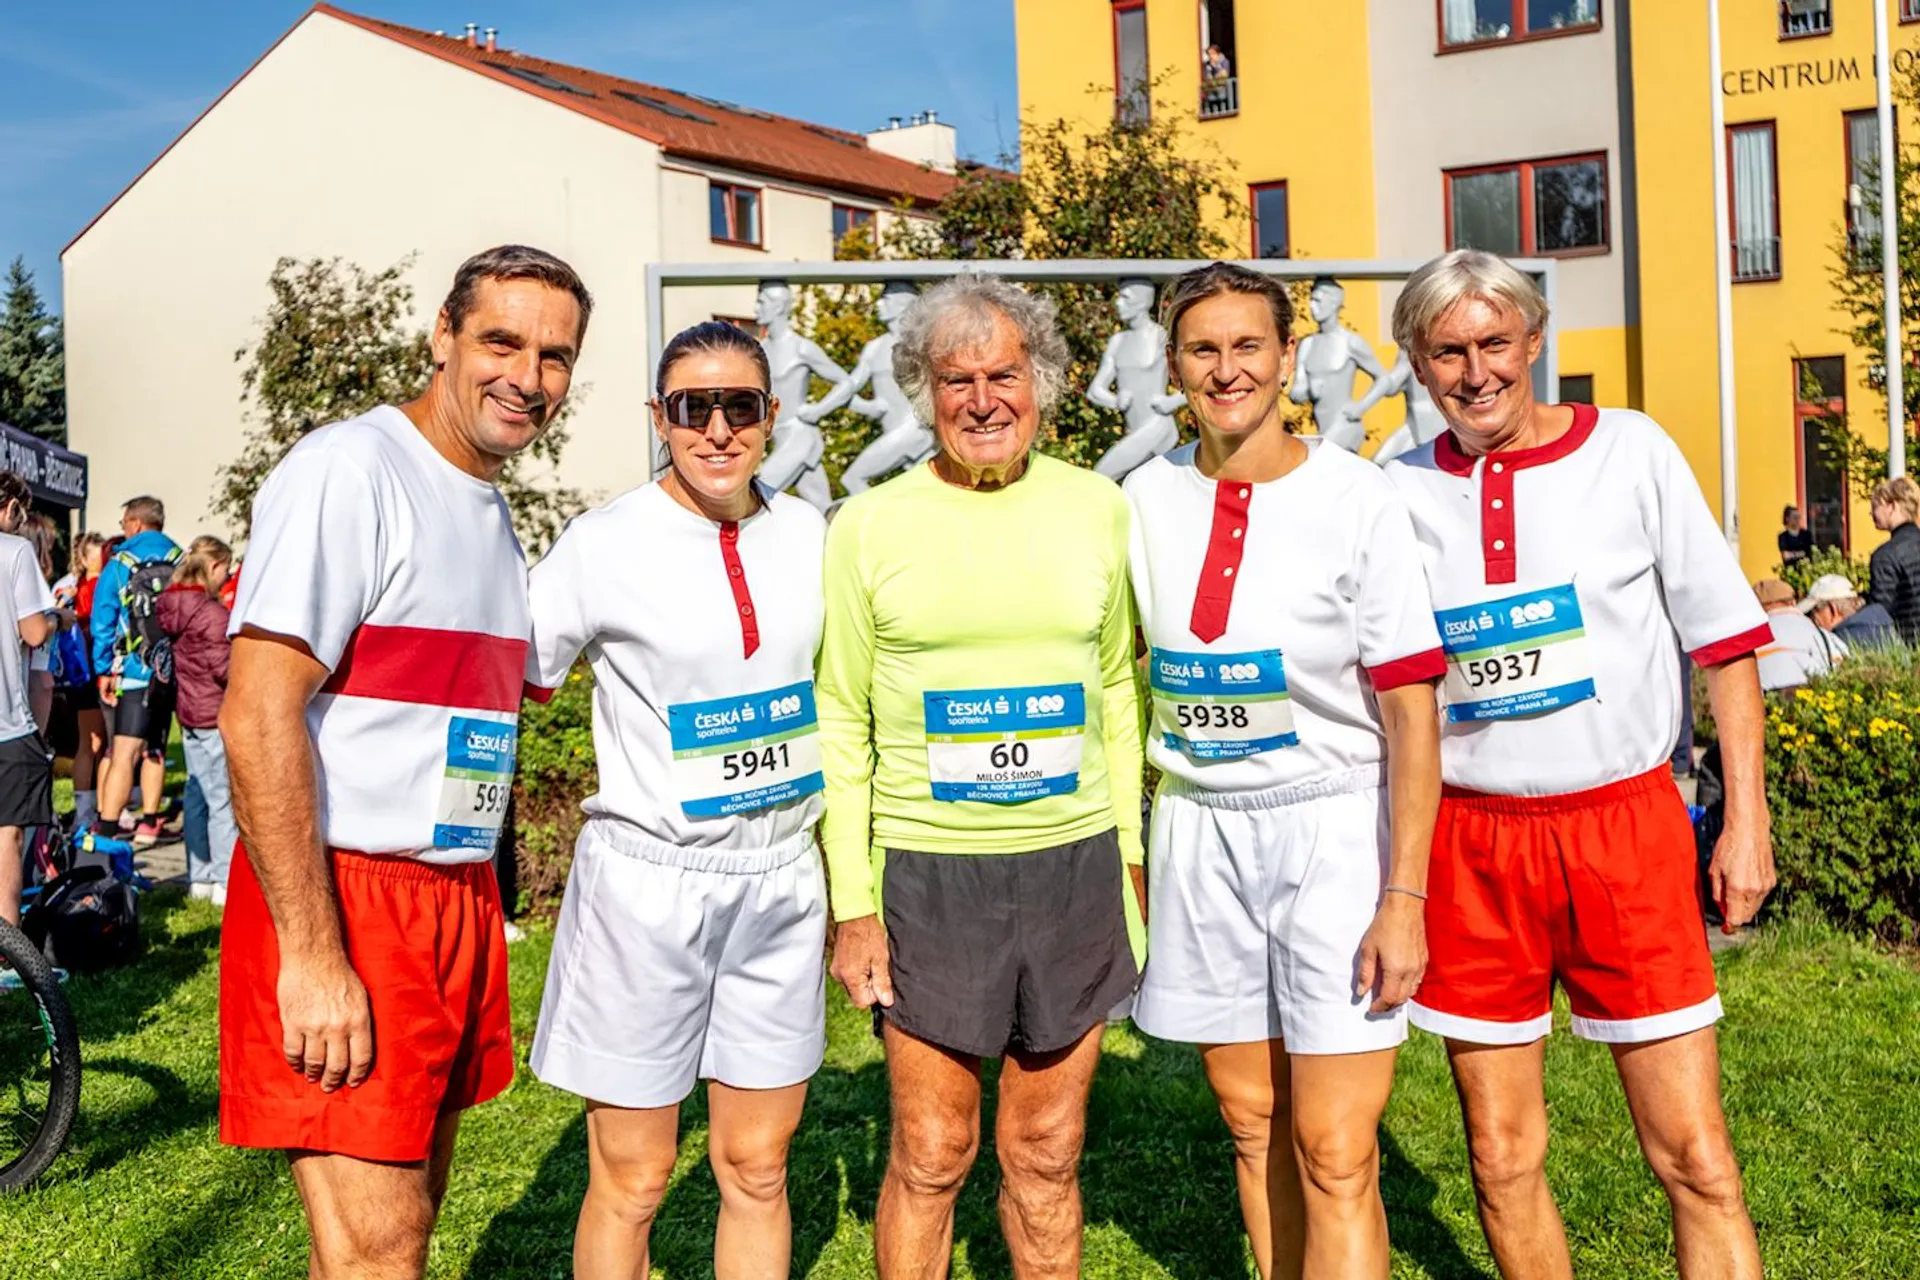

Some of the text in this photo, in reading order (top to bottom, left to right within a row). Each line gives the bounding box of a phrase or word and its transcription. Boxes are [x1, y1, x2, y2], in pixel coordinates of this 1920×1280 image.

[1722, 57, 1860, 96] CENTRUM
[1444, 614, 1478, 636] ČESKÁ
[1160, 659, 1191, 678] ČESKÁ
[1469, 649, 1542, 687] 5937
[695, 707, 741, 729] ČESKÁ
[947, 699, 993, 716] ČESKÁ
[1177, 704, 1249, 728] 5938
[467, 731, 500, 751] ČESKÁ
[723, 743, 789, 780] 5941
[990, 742, 1028, 768] 60
[976, 770, 1043, 782] MILOŠ ŠIMON
